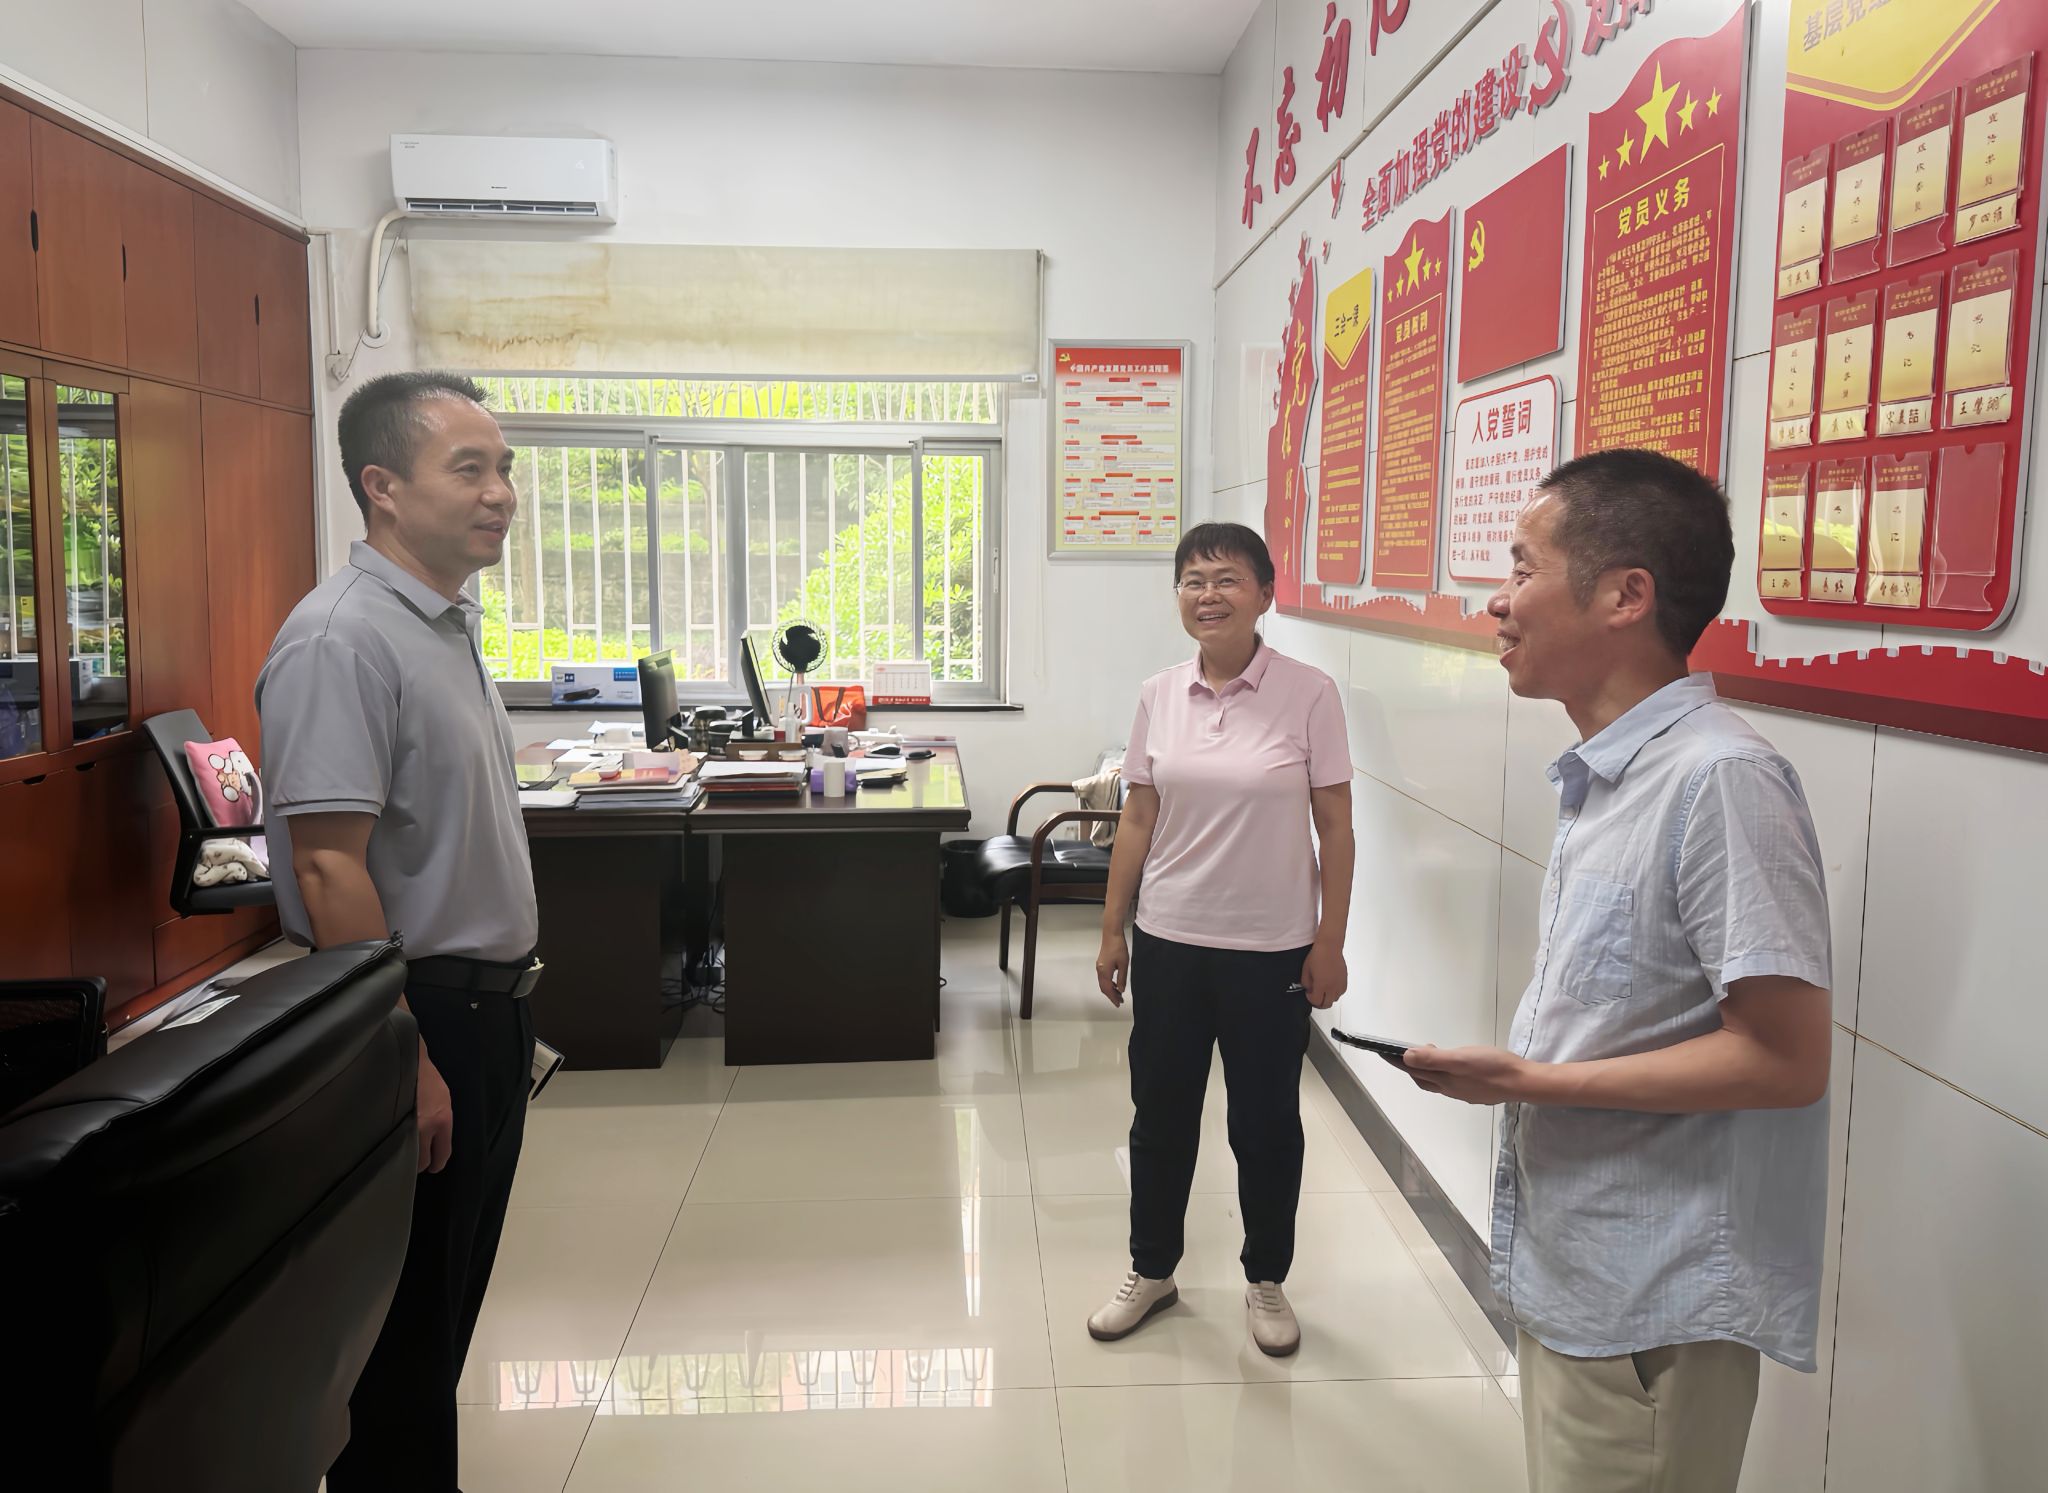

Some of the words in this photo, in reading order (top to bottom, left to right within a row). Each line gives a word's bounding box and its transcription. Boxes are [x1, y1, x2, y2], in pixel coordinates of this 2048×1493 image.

[1804, 0, 1888, 52] 基层党
[1361, 43, 1528, 231] 全面加强党的建设
[1617, 176, 1690, 239] 党员义务
[1472, 399, 1532, 445] 入党誓词
